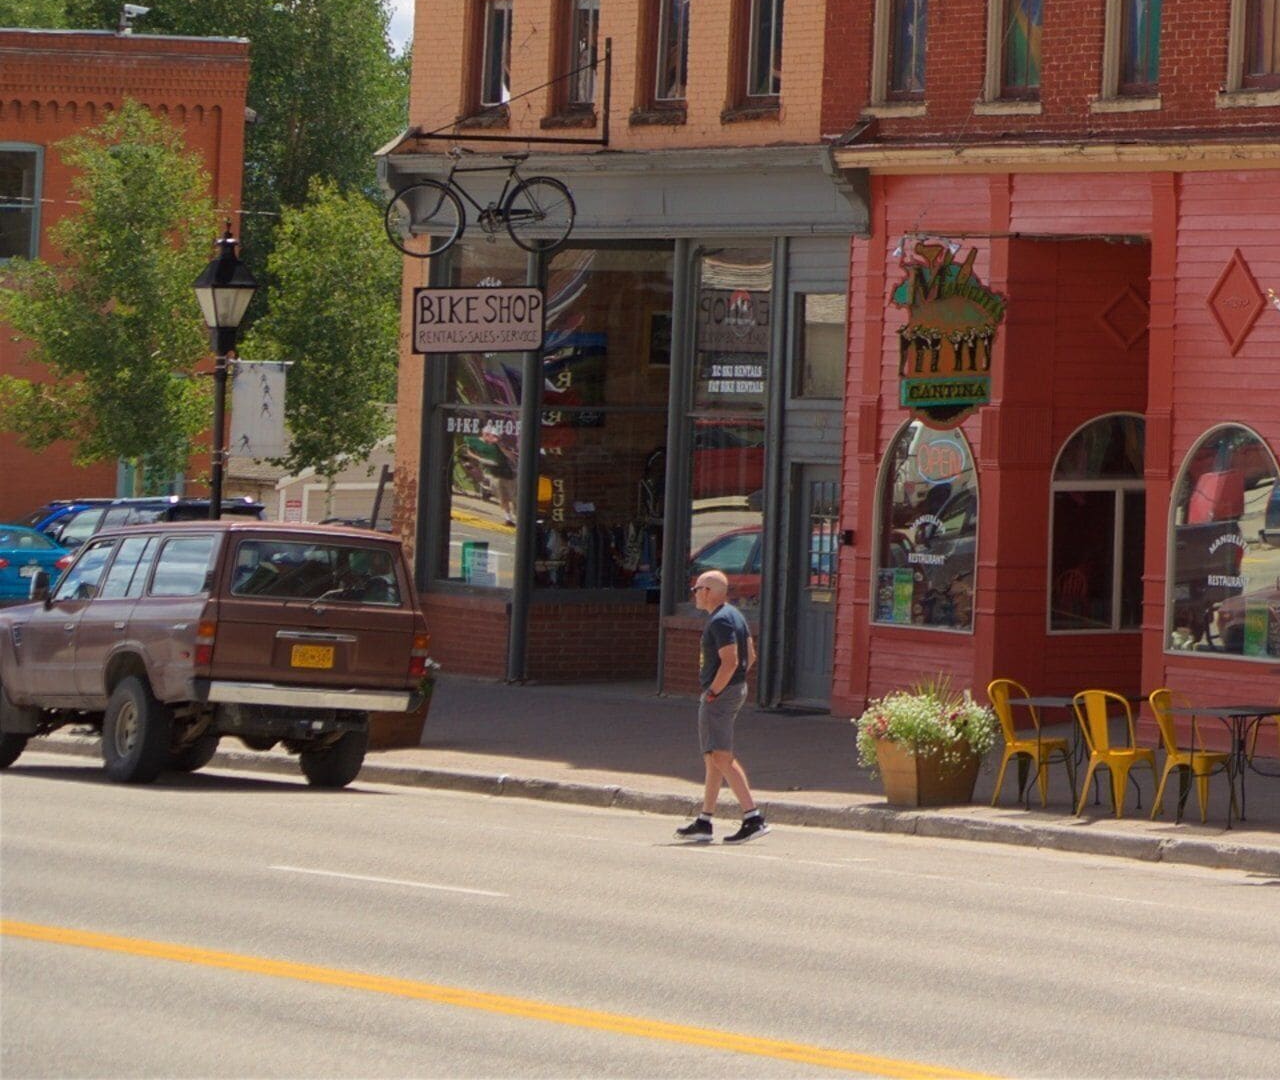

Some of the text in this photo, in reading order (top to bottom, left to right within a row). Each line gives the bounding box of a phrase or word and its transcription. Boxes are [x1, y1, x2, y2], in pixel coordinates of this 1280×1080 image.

[419, 295, 540, 324] BIKE SHOP
[908, 383, 985, 400] CANTINA
[447, 418, 480, 433] BIKE
[918, 444, 962, 481] OPEN
